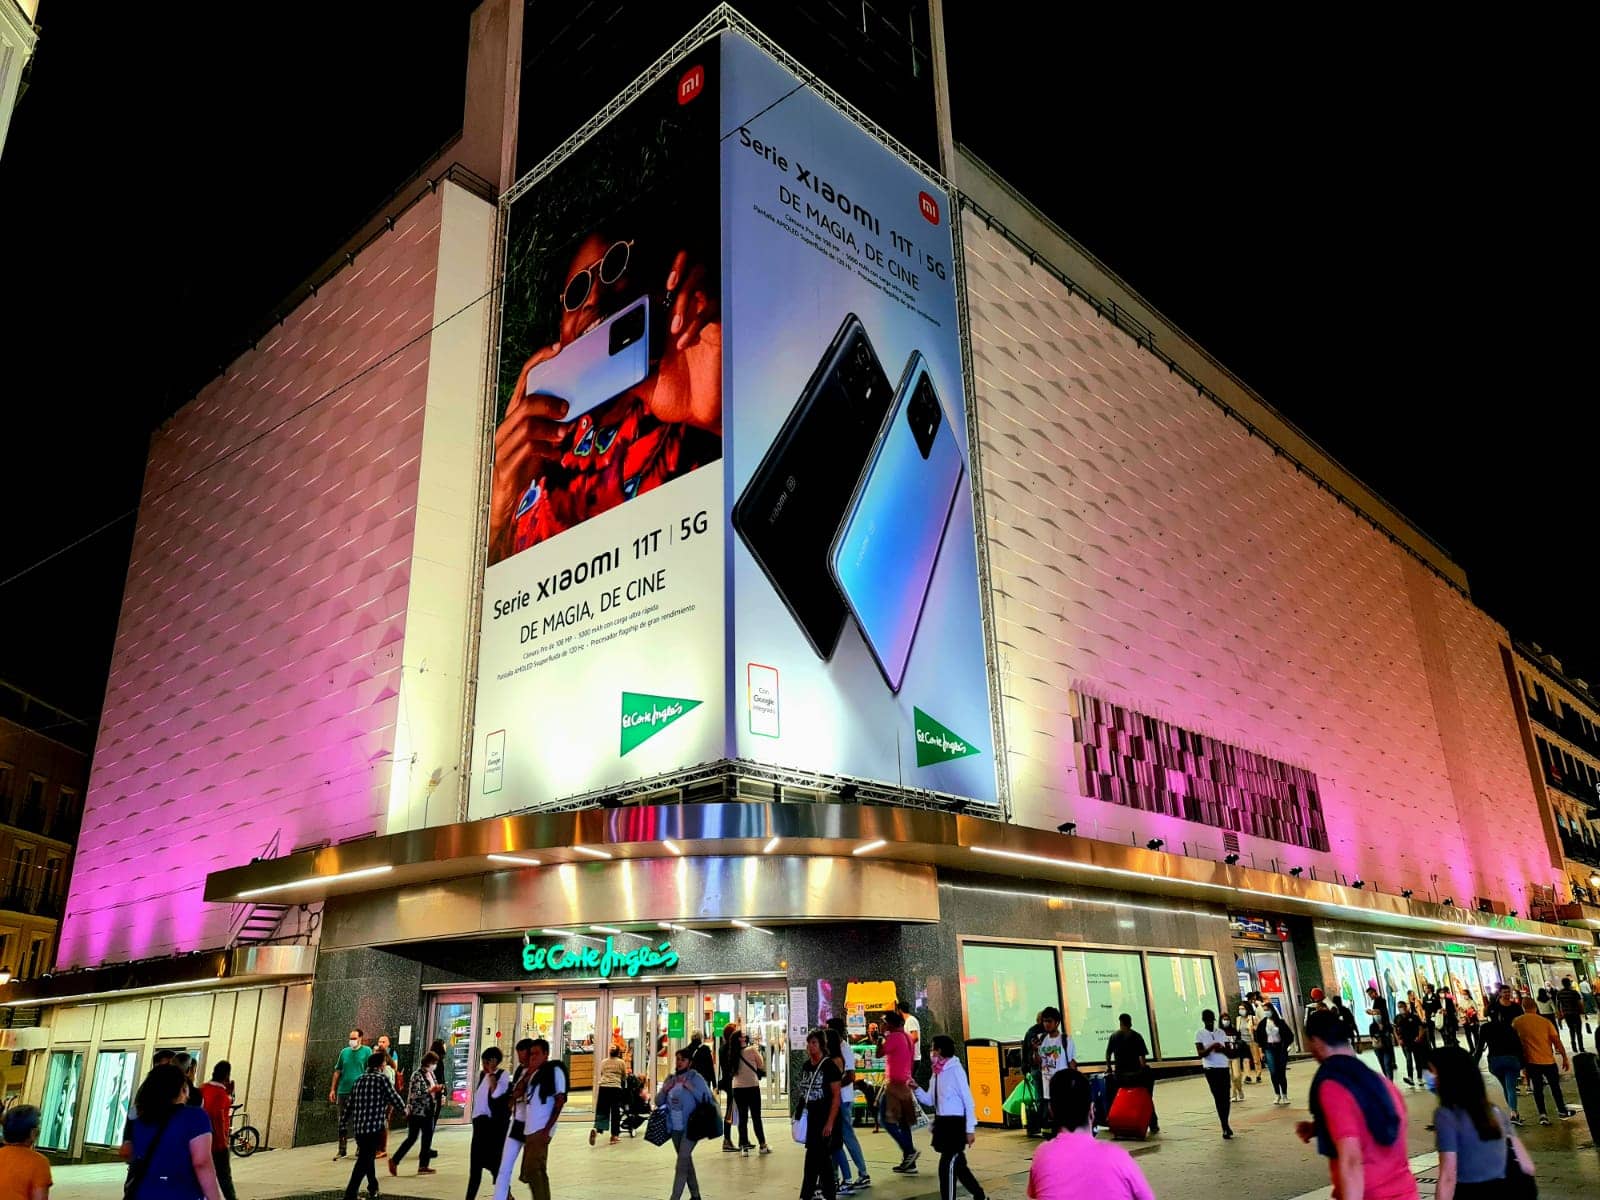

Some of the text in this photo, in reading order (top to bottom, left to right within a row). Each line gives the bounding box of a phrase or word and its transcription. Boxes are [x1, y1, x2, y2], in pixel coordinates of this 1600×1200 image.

[739, 126, 788, 172] Serie
[890, 230, 913, 257] 11T
[926, 254, 945, 280] 5G
[779, 185, 920, 291] DE MAGIA, DE CINE
[493, 590, 530, 620] Serie
[632, 529, 662, 560] 11T
[680, 510, 708, 541] 5G
[520, 569, 666, 644] DE MAGIA, DE CINE
[522, 936, 679, 977] El Corte Inglés
